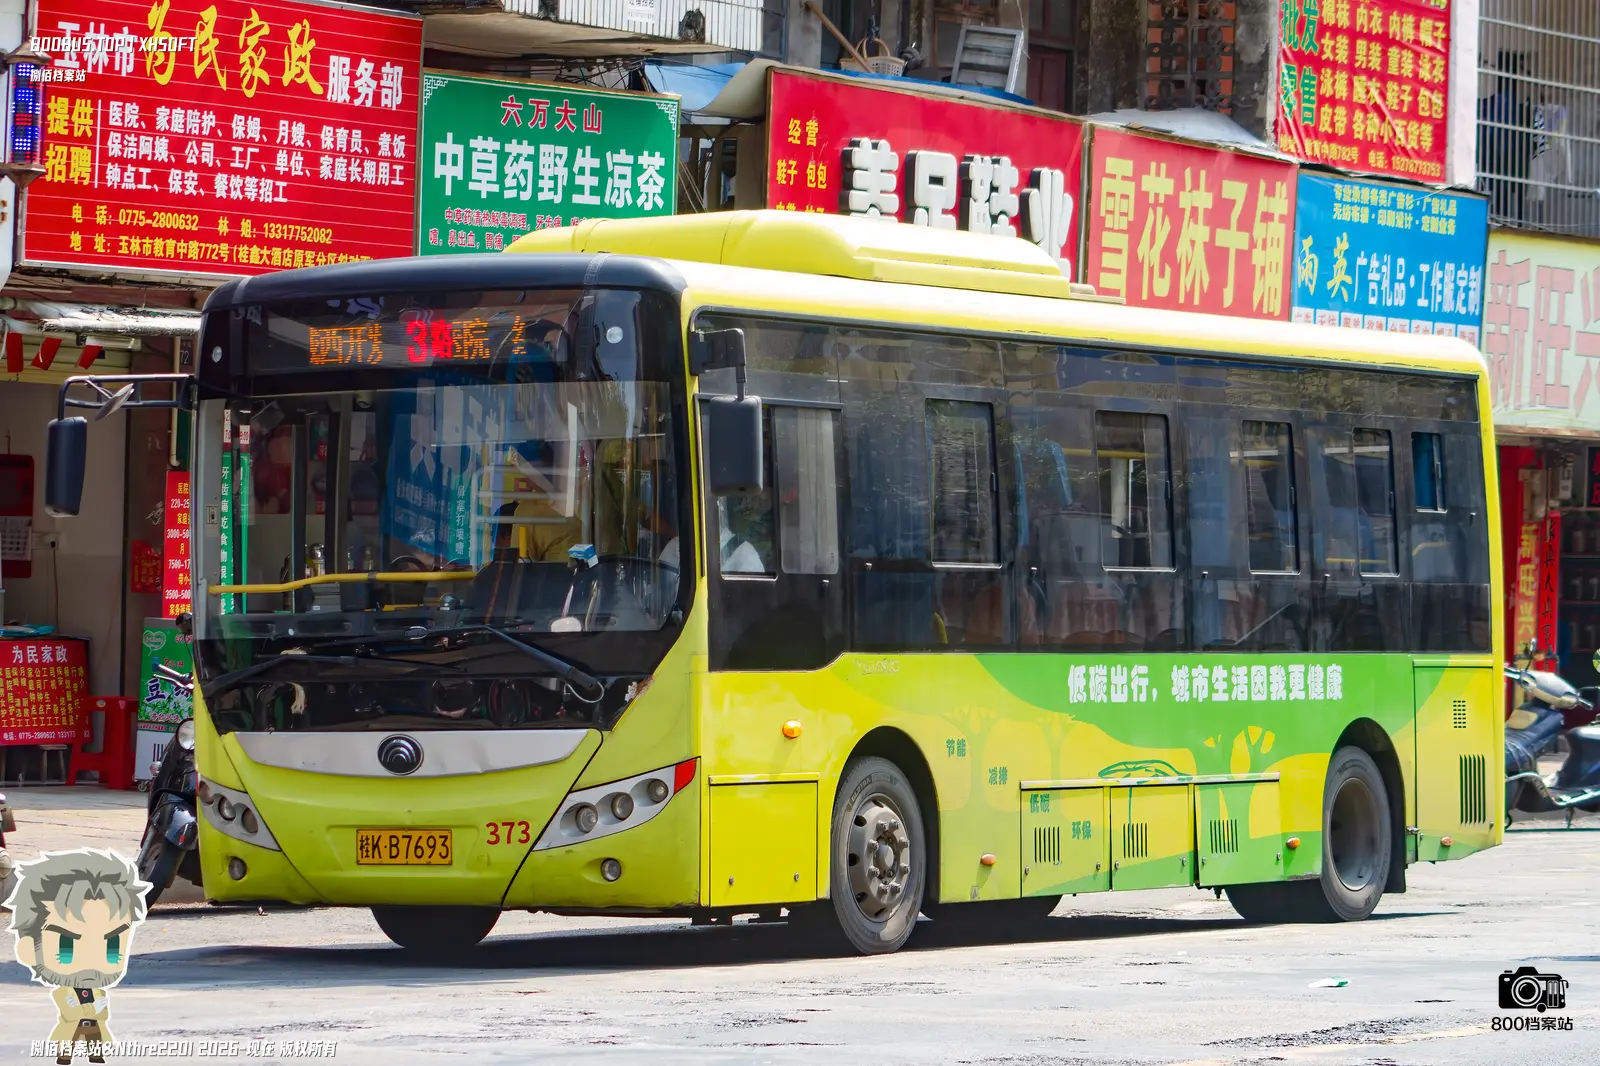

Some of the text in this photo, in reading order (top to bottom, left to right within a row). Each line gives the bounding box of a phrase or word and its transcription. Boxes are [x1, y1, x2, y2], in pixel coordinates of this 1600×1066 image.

[1281, 0, 1318, 55] 批发
[1356, 4, 1383, 35] 内衣
[1389, 10, 1415, 44] 内裤
[1419, 17, 1446, 50] 帽子
[1321, 32, 1349, 65] 女装
[1354, 39, 1382, 72] 男装
[1387, 46, 1413, 79] 童装
[326, 54, 404, 111] 服务部
[1281, 63, 1317, 126] 零售
[1386, 80, 1413, 112] 鞋子
[1417, 87, 1444, 119] 包包
[46, 95, 94, 137] 提供
[500, 95, 602, 134] 六万大山
[788, 117, 819, 147] 经营
[1319, 103, 1347, 136] 皮带
[45, 142, 92, 186] 招聘
[434, 132, 666, 211] 中草药野生凉茶
[776, 159, 828, 189] 鞋子 包包
[841, 137, 1073, 281] 美足鞋业
[1100, 157, 1289, 316] 雪花袜子铺
[12, 645, 68, 664] 为民家政
[1171, 663, 1343, 702] 城市生活因我更健康
[946, 739, 966, 757] 节能
[485, 820, 530, 845] 373
[1071, 820, 1092, 840] 环保
